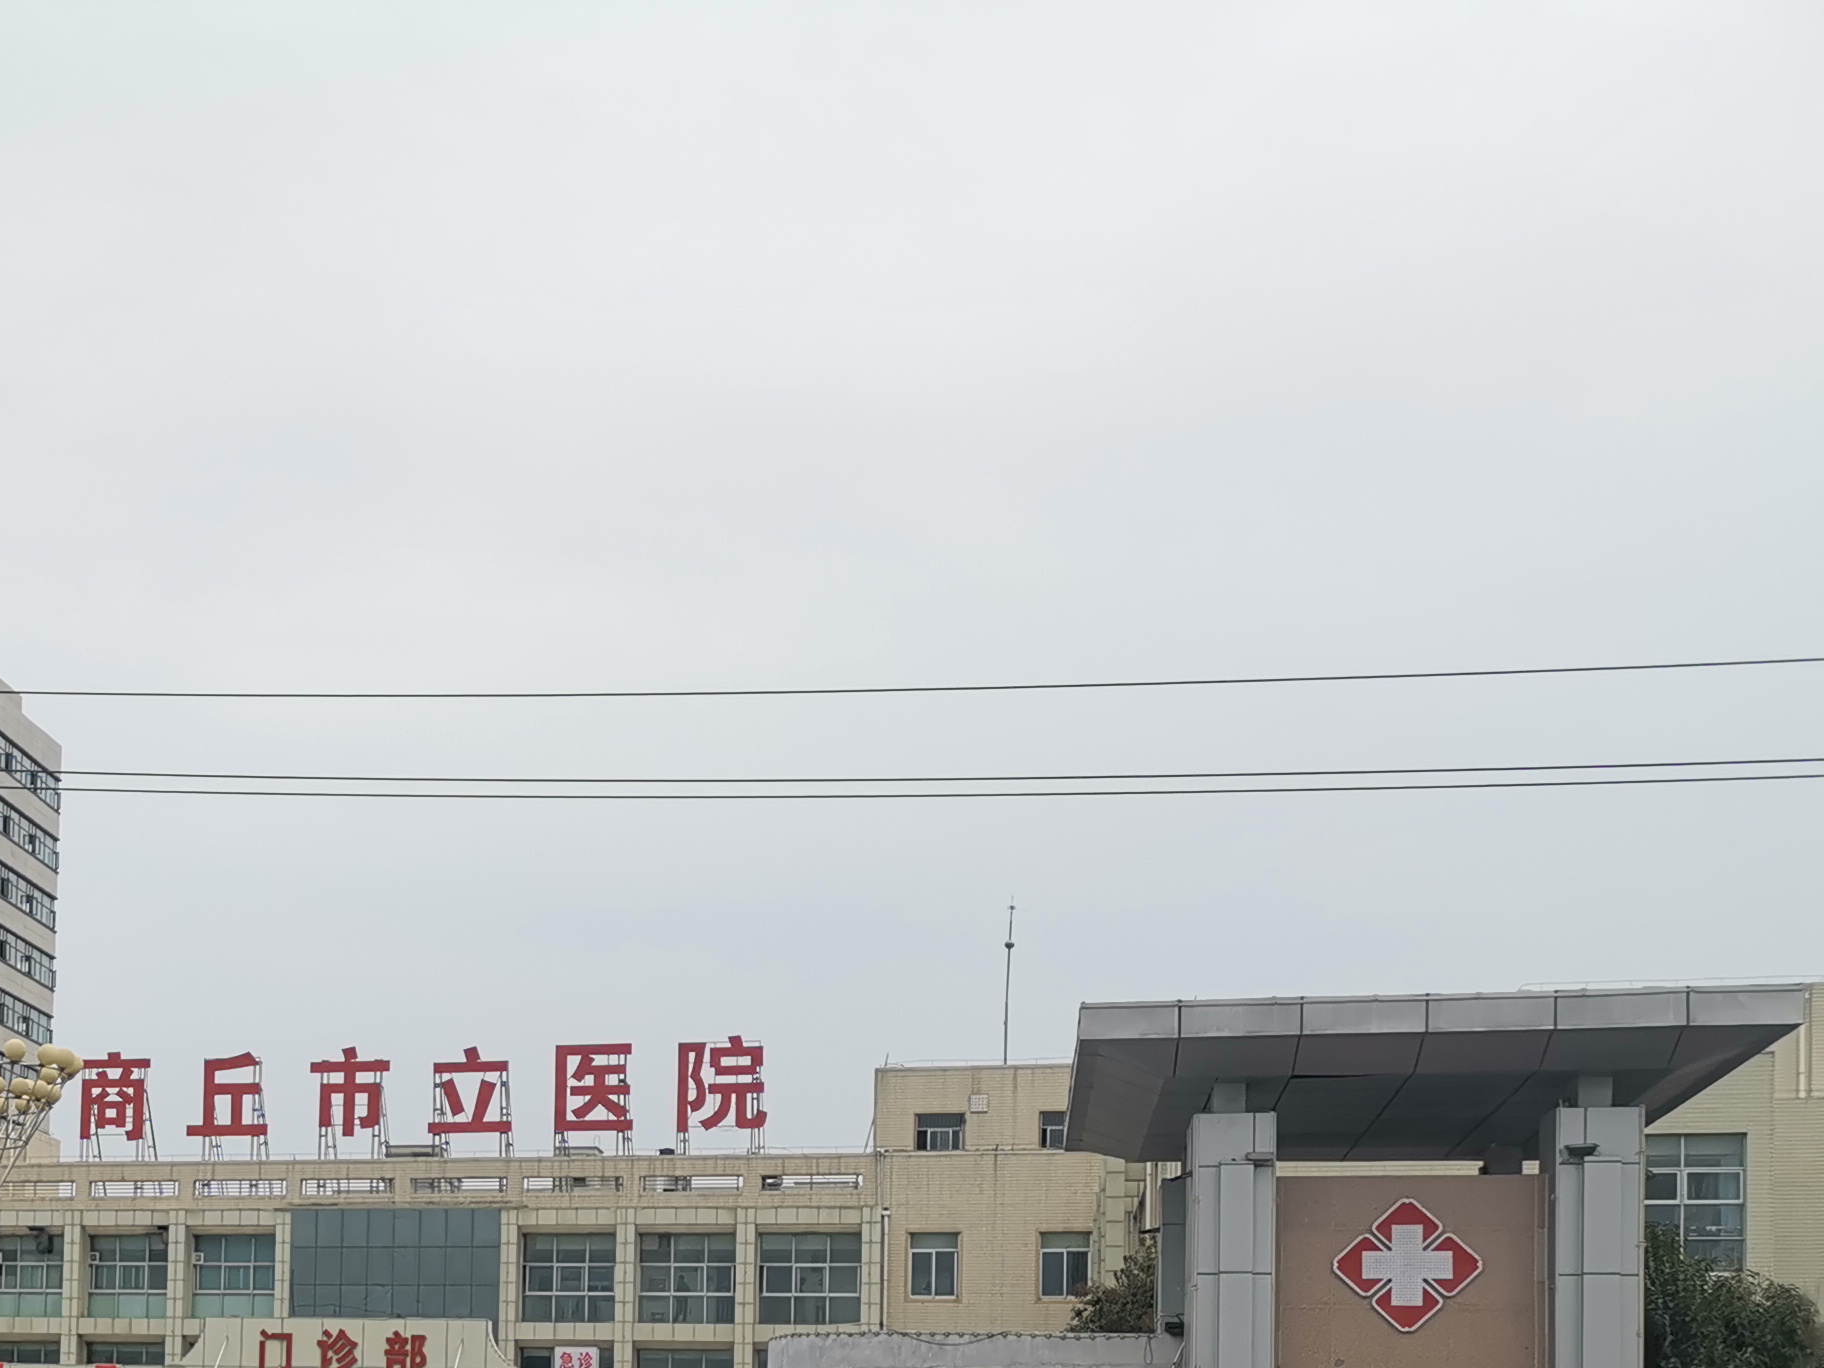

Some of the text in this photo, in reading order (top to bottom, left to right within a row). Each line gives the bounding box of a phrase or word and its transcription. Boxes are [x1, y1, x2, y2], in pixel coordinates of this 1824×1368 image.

[79, 1035, 769, 1141] 商丘市立医院
